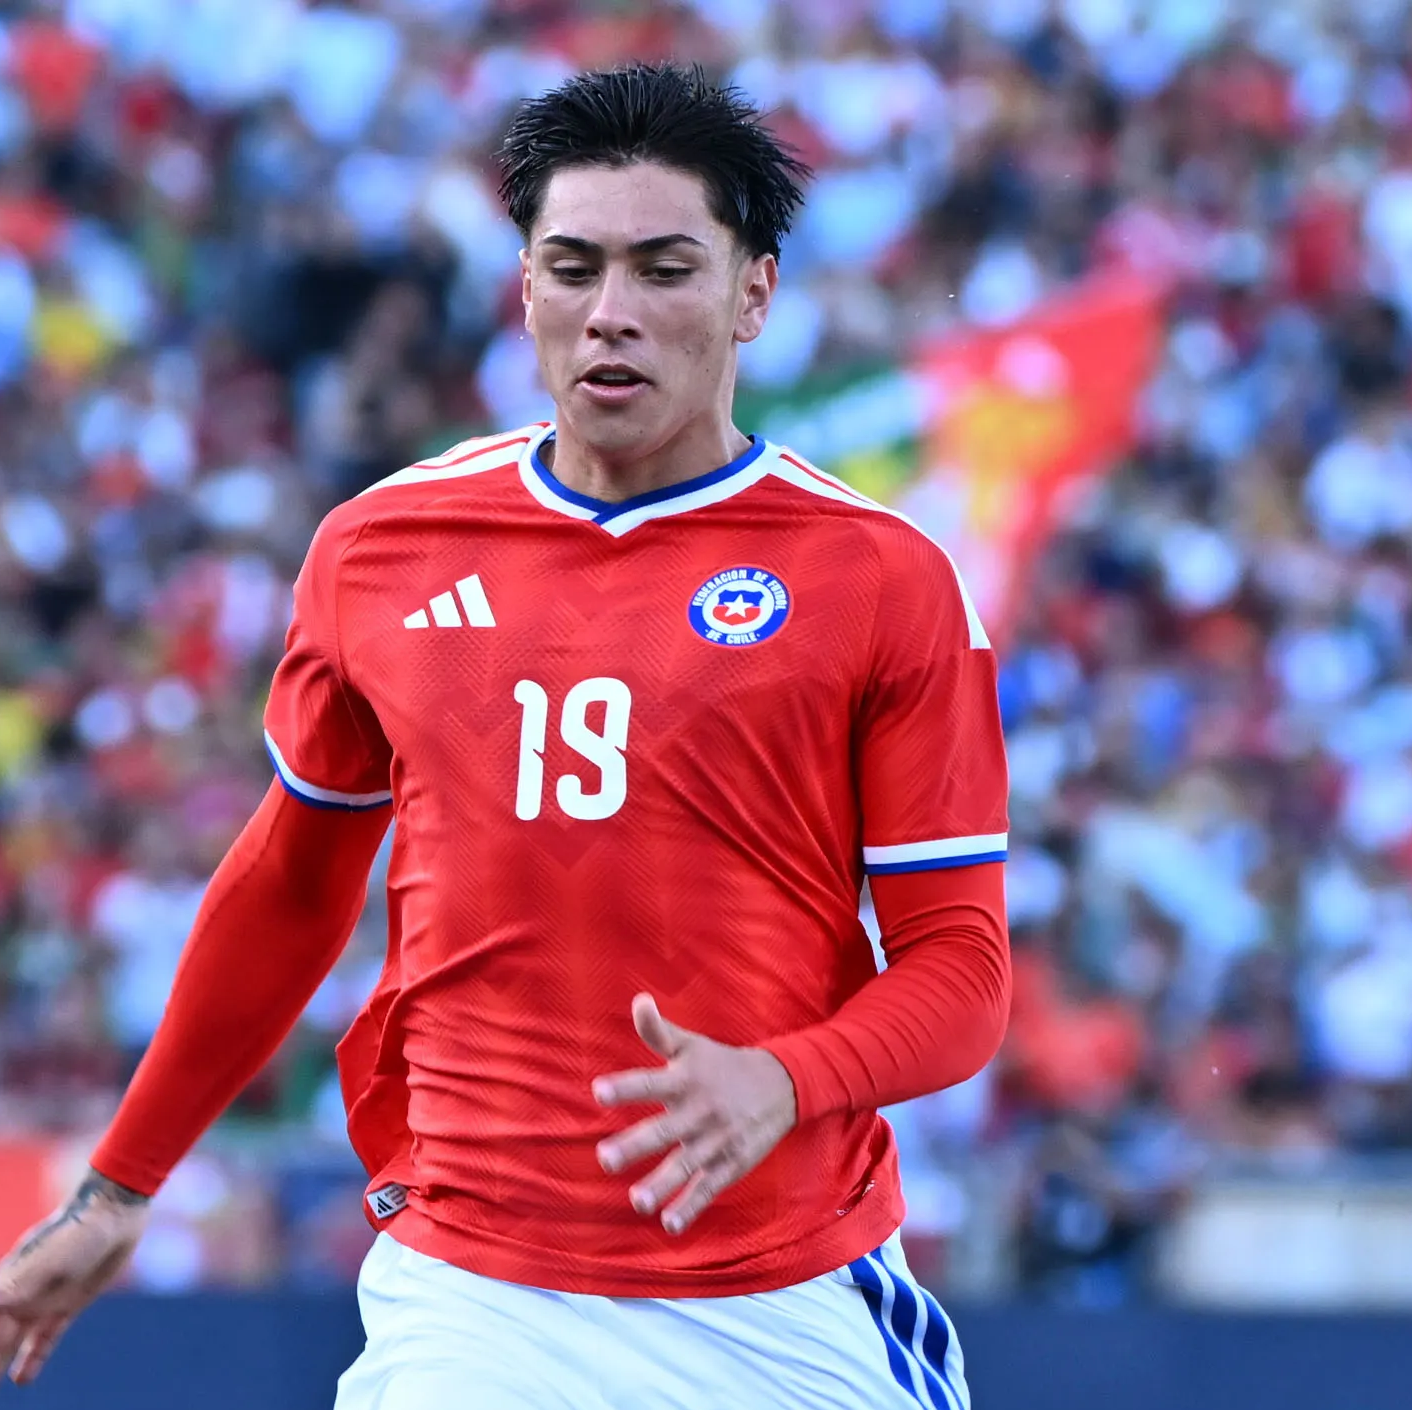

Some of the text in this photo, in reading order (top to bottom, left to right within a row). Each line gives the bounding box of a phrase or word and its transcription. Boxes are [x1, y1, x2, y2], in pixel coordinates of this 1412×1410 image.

[692, 569, 789, 611] FEDERACION DE FUTBOL
[706, 629, 758, 645] DE CHILE
[513, 676, 633, 821] 19
